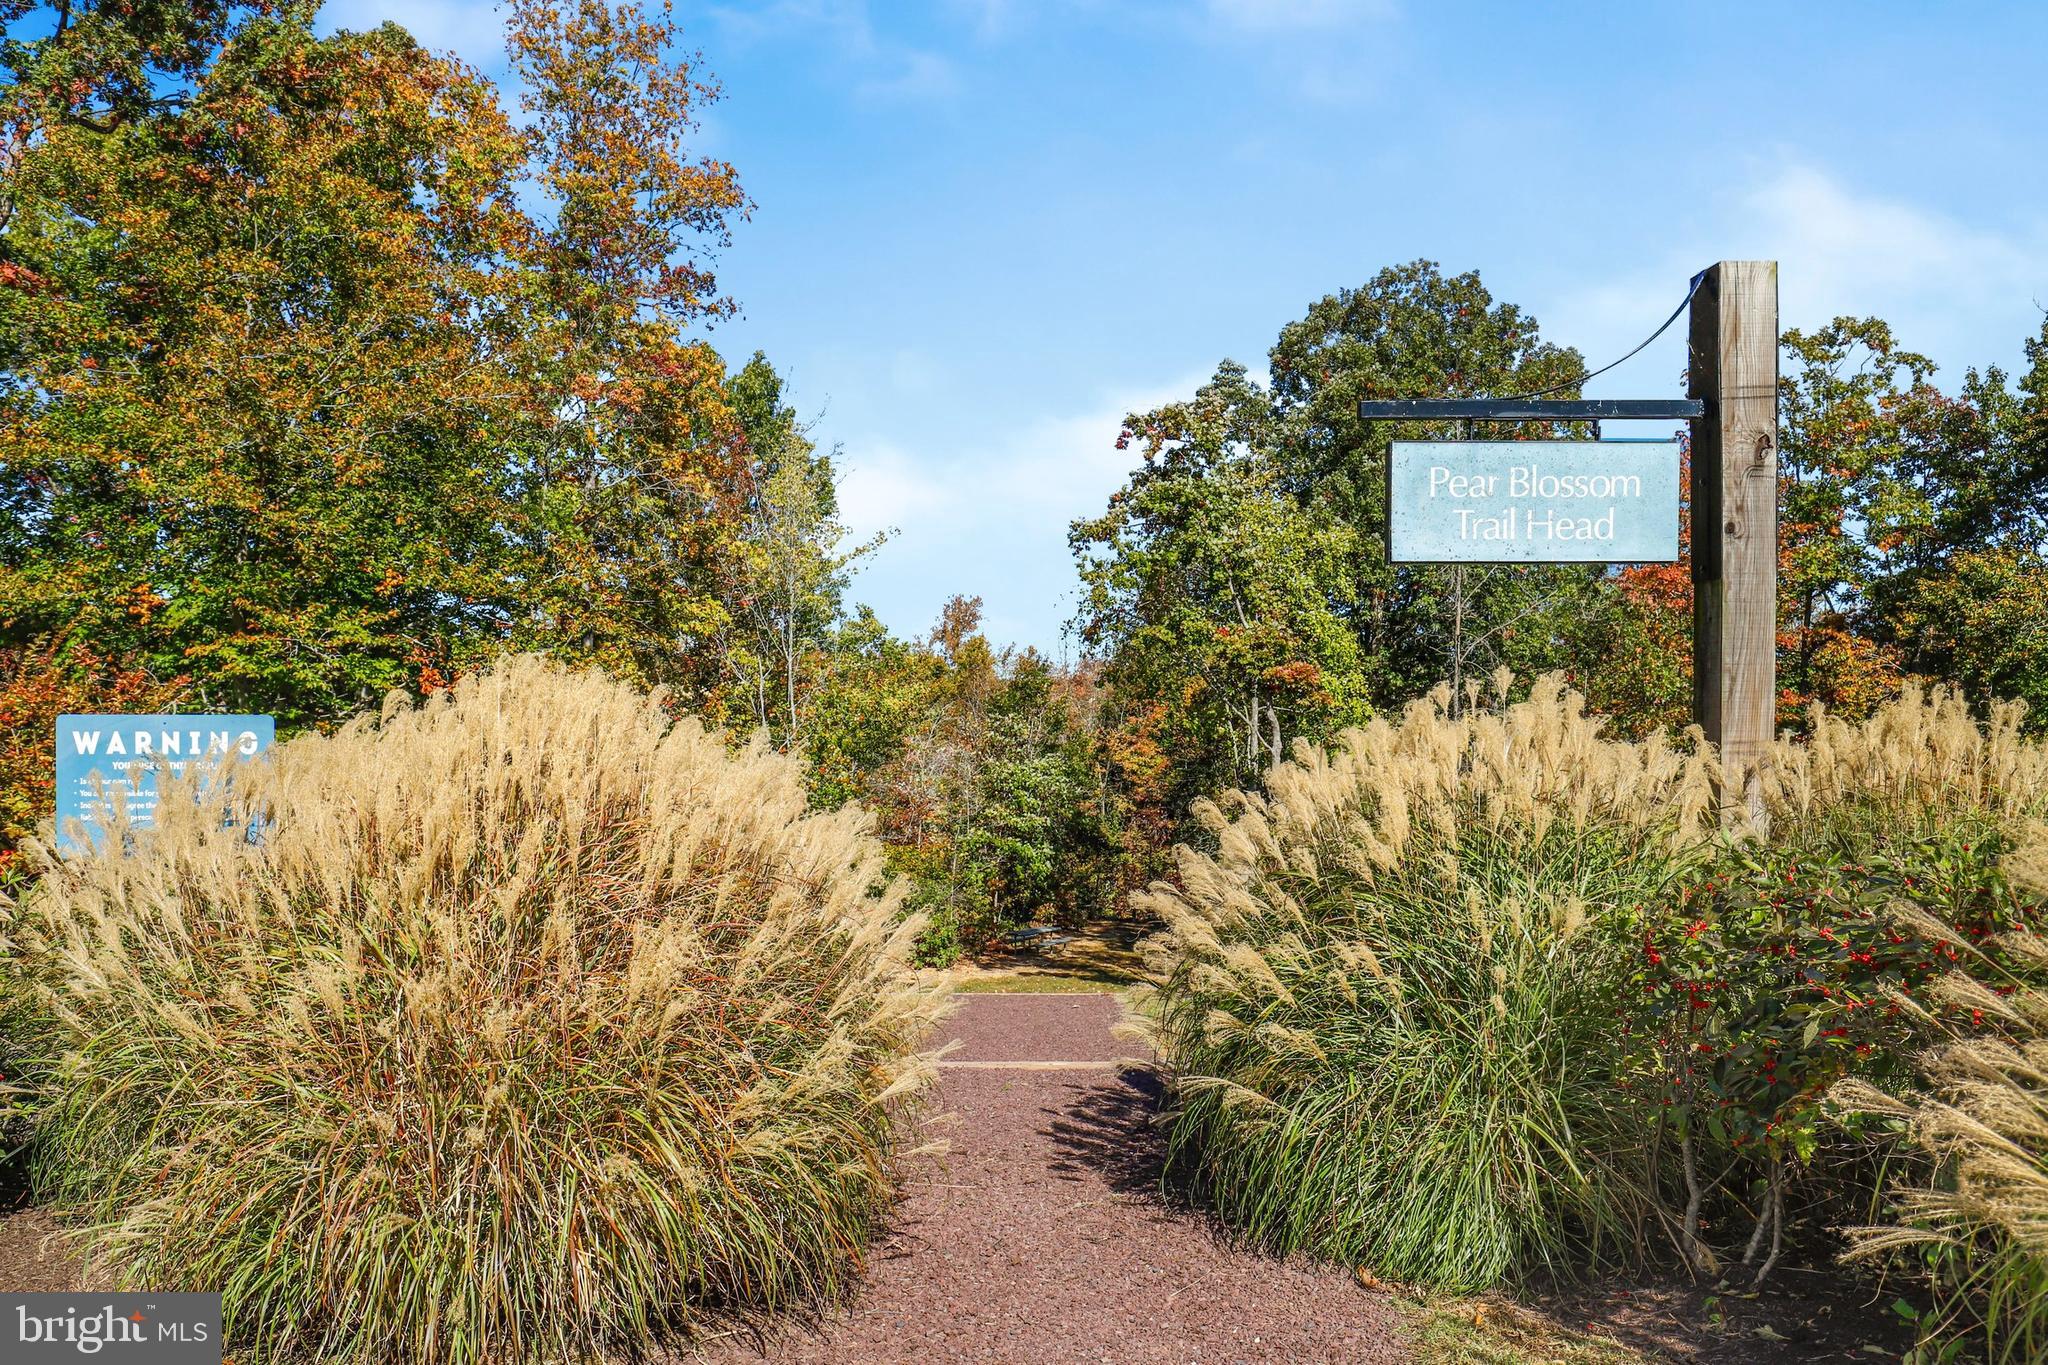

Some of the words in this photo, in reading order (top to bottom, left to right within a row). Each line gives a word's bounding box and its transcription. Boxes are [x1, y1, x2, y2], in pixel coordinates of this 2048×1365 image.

[1429, 466, 1498, 498] Pear
[1510, 463, 1641, 498] Blossom
[1453, 507, 1517, 540] Trail
[1527, 507, 1615, 540] Head
[72, 730, 259, 755] WARNING
